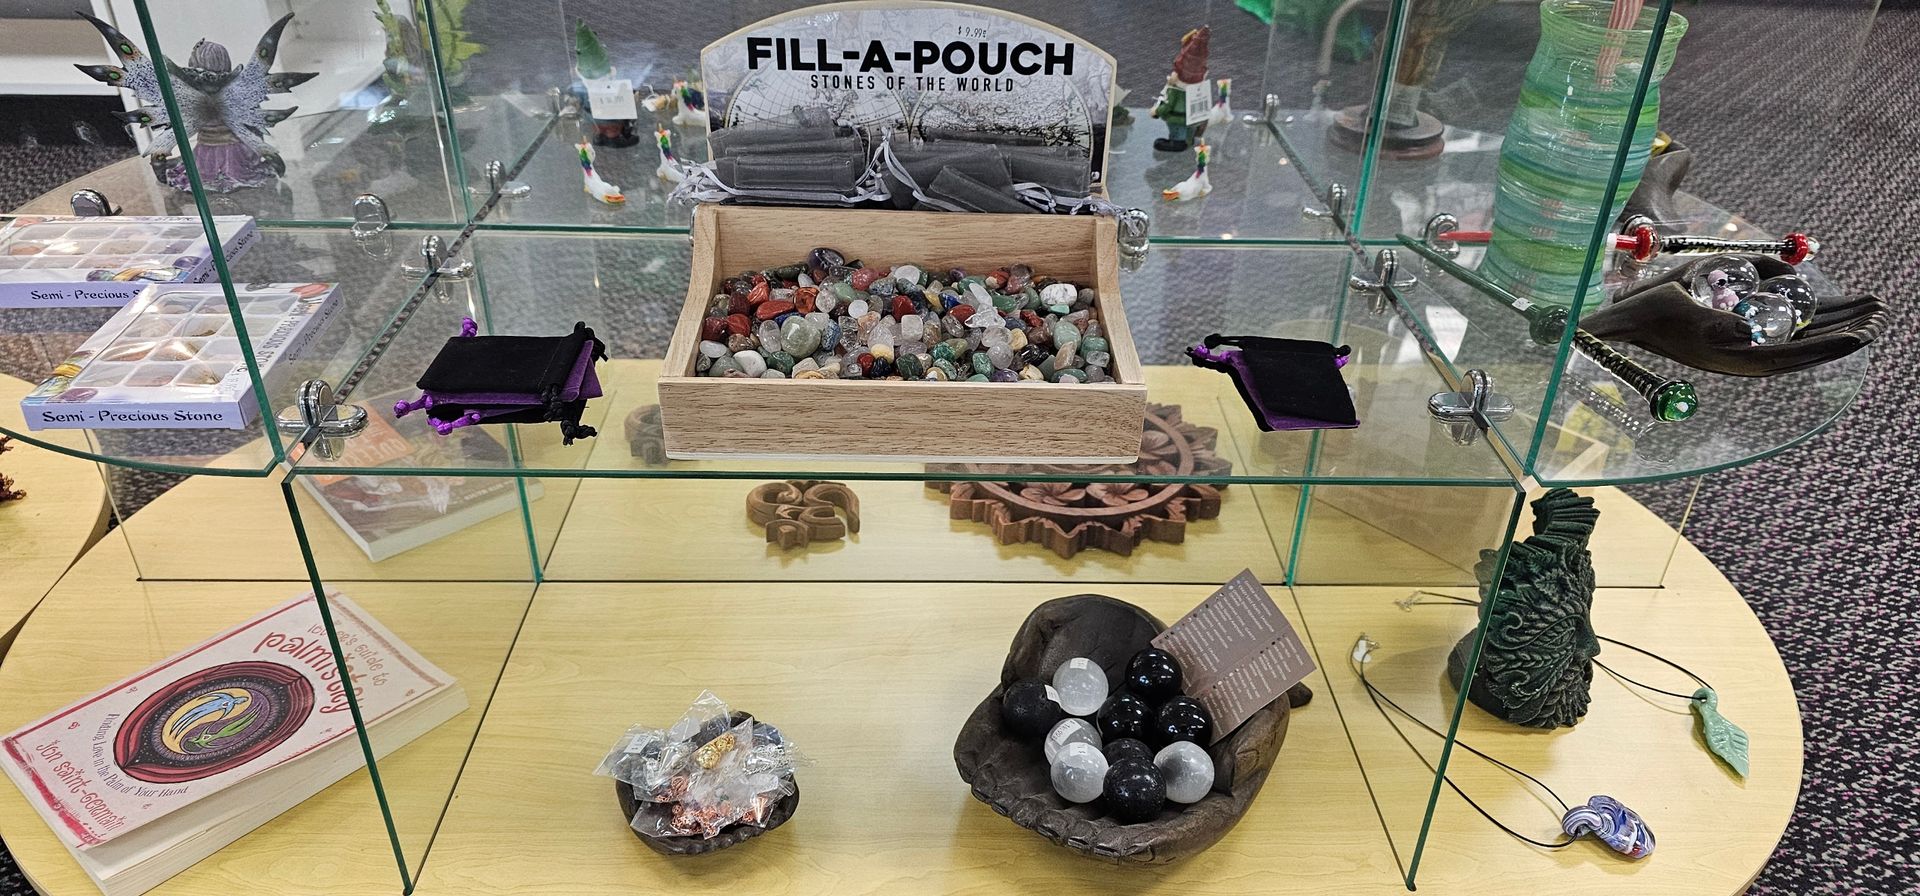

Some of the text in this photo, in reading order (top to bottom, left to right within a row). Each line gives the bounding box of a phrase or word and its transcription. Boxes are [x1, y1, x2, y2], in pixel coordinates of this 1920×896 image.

[747, 37, 1075, 76] FILL-A-POUCH
[810, 74, 1014, 92] STONES OF THE WORLD
[30, 289, 64, 300] Semi
[74, 289, 130, 300] Precious
[42, 409, 84, 423] Semi
[98, 409, 169, 422] Precious
[174, 409, 223, 422] Stone
[92, 713, 189, 797] Finding Love in the Palm of Your Hand
